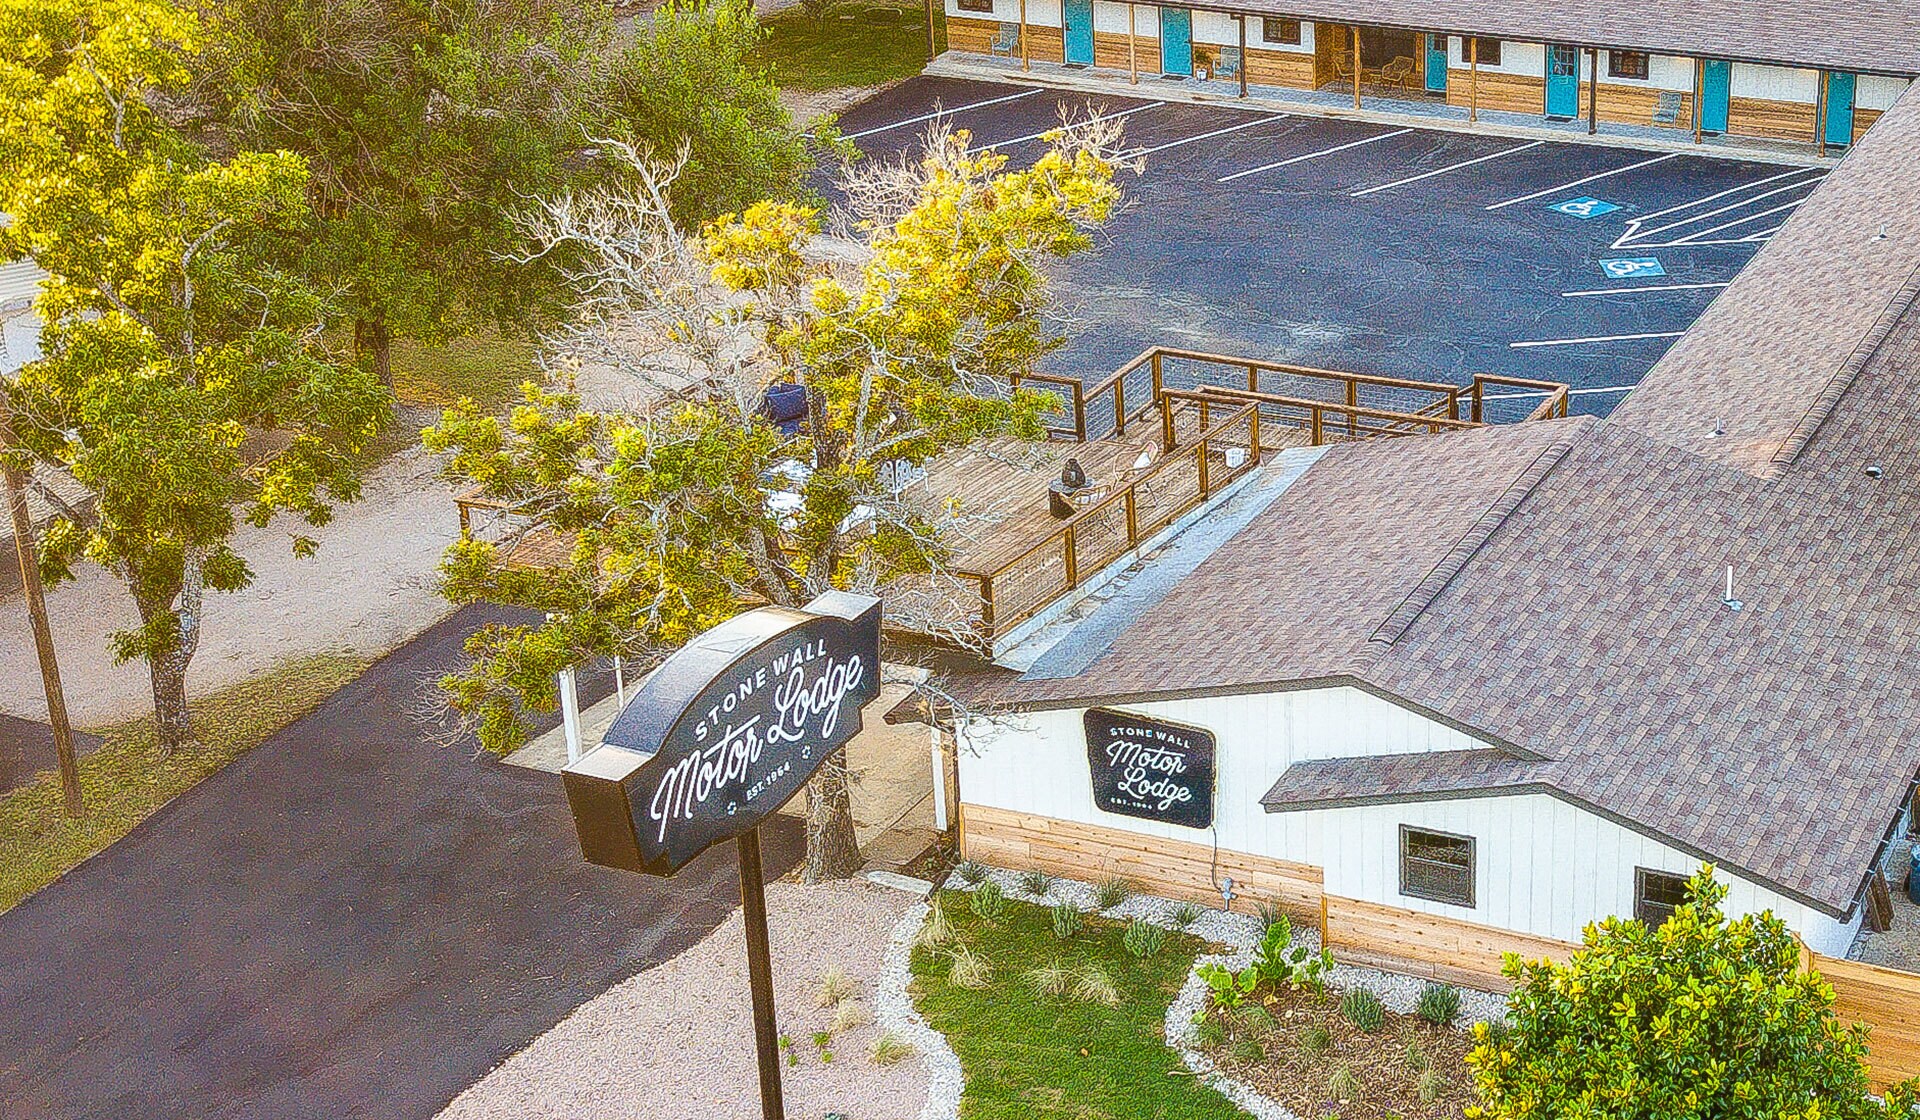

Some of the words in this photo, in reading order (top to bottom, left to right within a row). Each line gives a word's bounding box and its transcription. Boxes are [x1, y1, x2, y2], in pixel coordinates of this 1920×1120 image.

[695, 667, 767, 742] STONE
[773, 638, 827, 676] WALL
[650, 714, 764, 843] Motor
[767, 655, 864, 739] Lodge
[1106, 740, 1187, 776] Motor
[1109, 727, 1153, 738] STONE
[1156, 731, 1190, 749] WALL
[746, 781, 765, 801] EST.
[766, 761, 791, 785] 1964
[1117, 766, 1192, 811] Lodge
